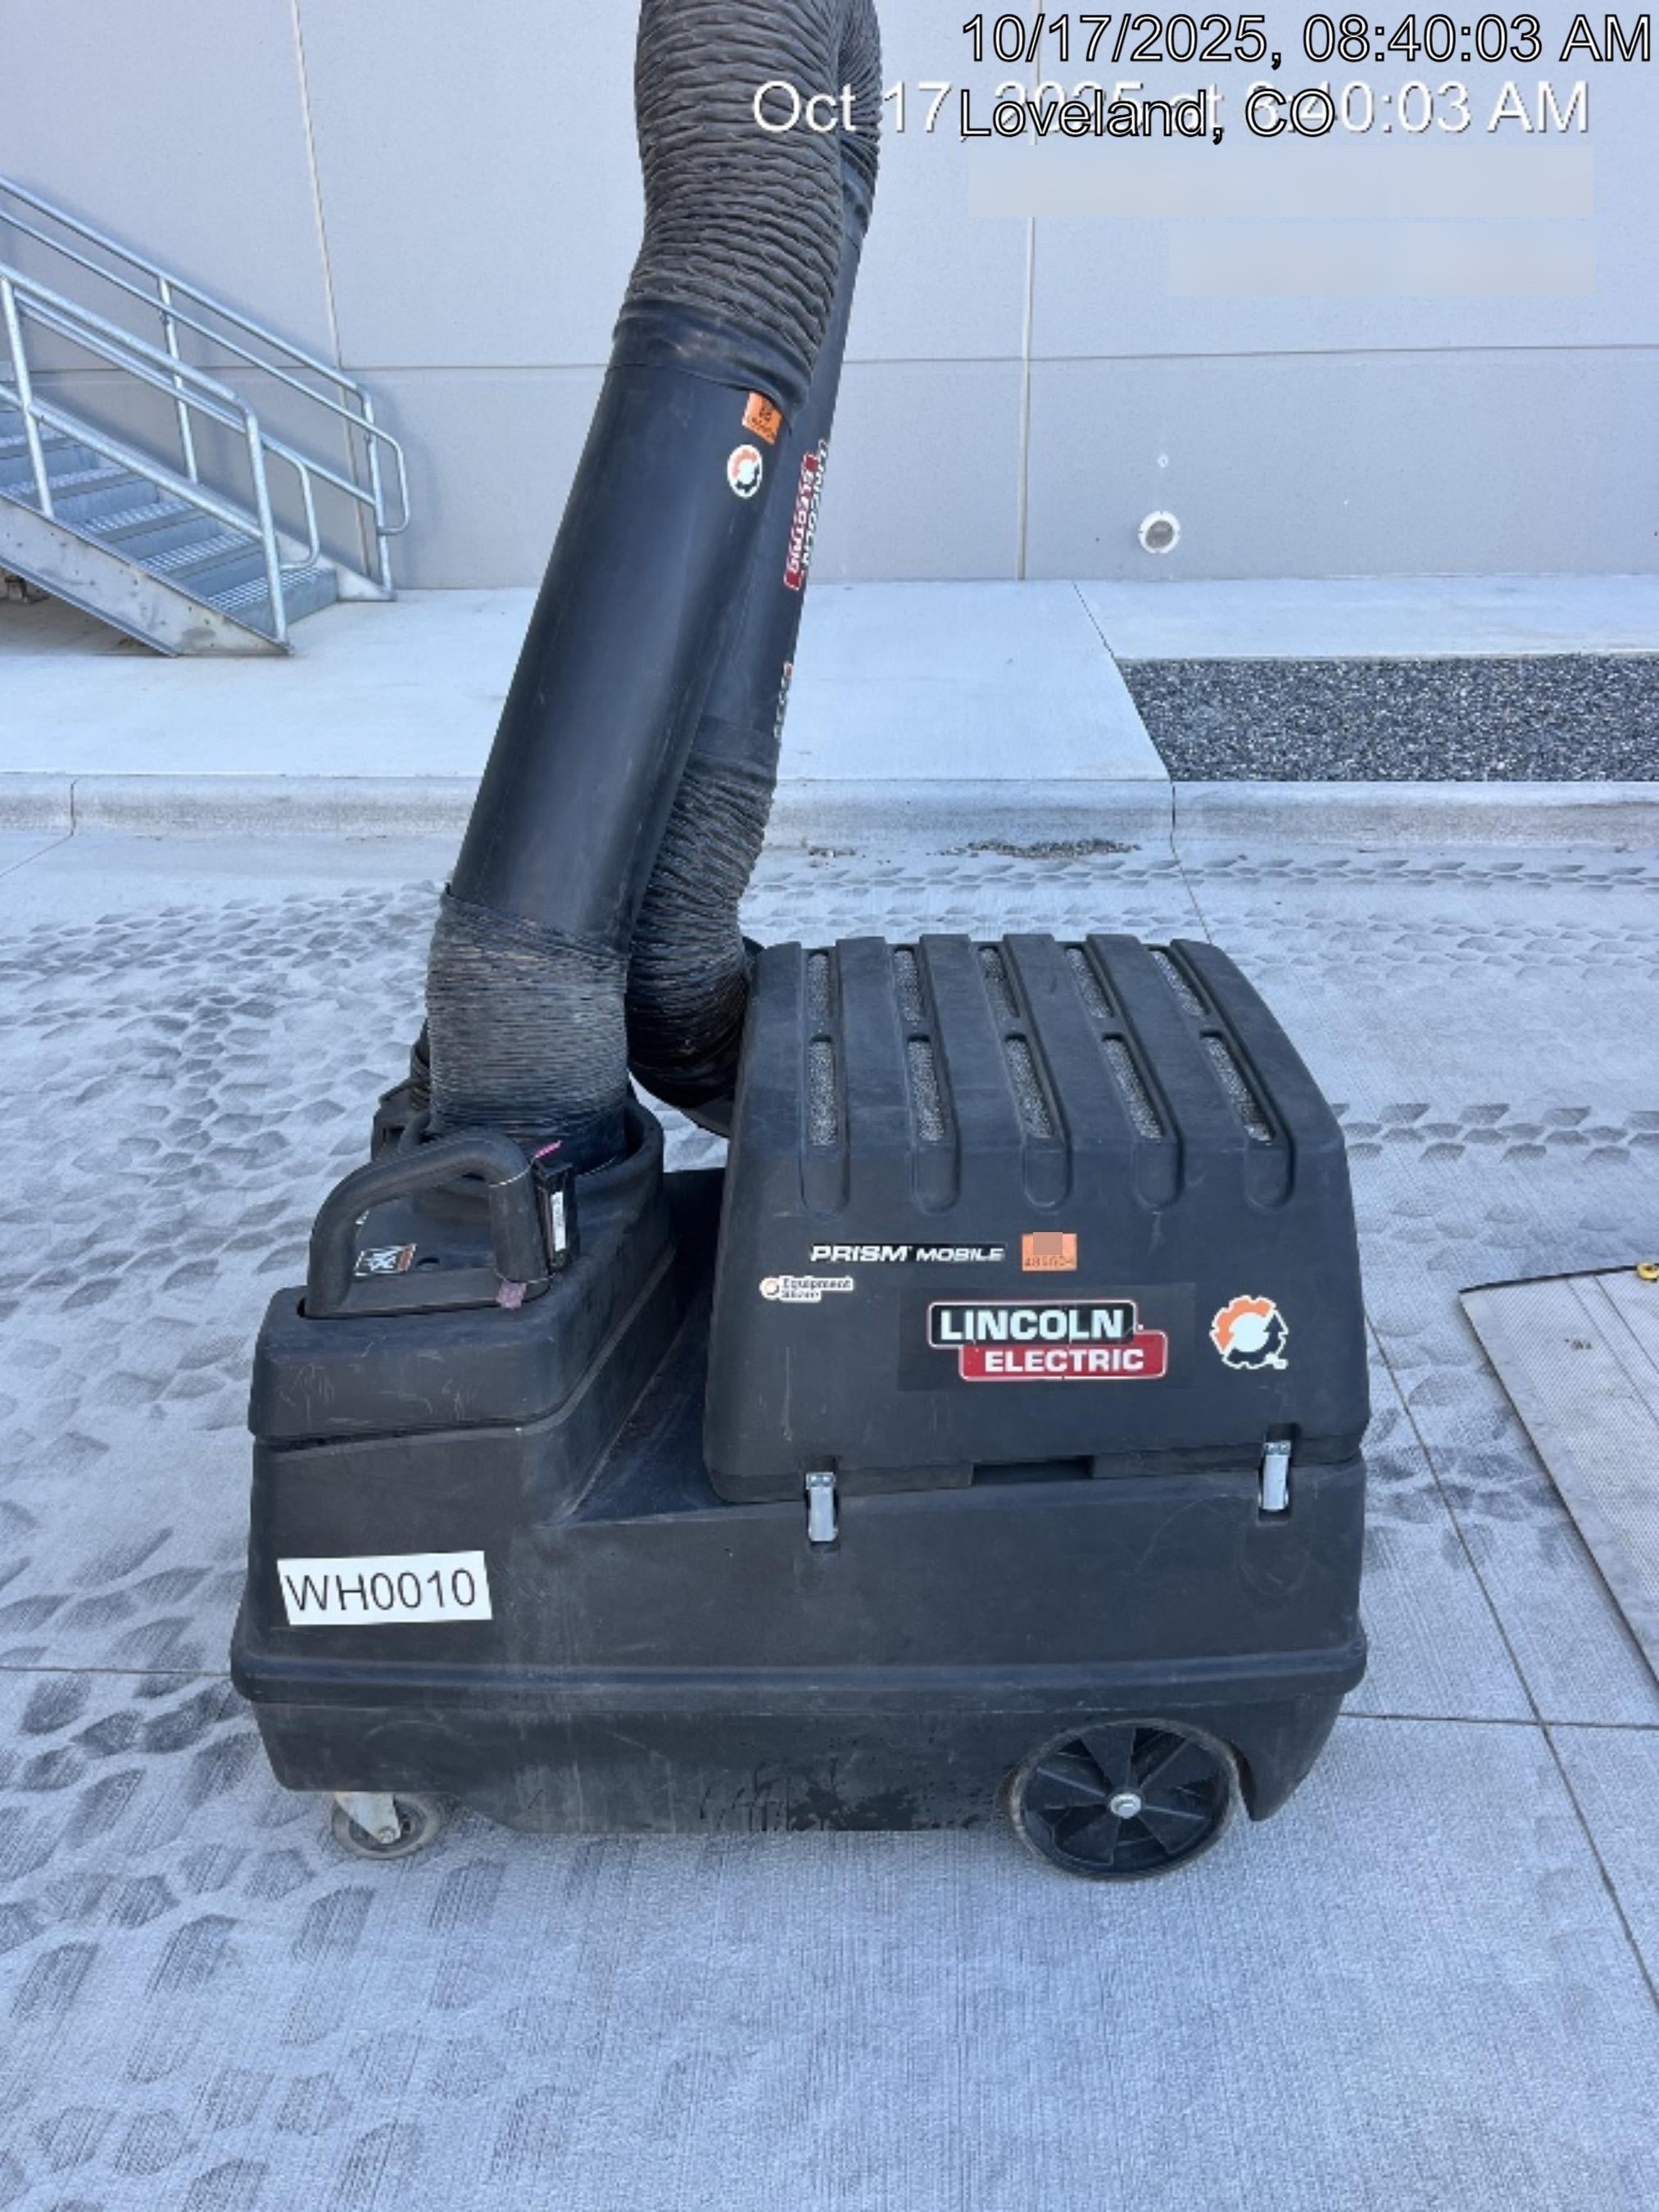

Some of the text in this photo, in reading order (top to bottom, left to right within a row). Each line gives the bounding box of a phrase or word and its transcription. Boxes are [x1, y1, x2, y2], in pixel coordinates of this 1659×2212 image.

[810, 1244, 1005, 1262] PRISM MOBILE
[941, 1309, 1125, 1341] LINCOLN
[985, 1349, 1145, 1372] ELECTRIC
[284, 1567, 475, 1611] WH0010
